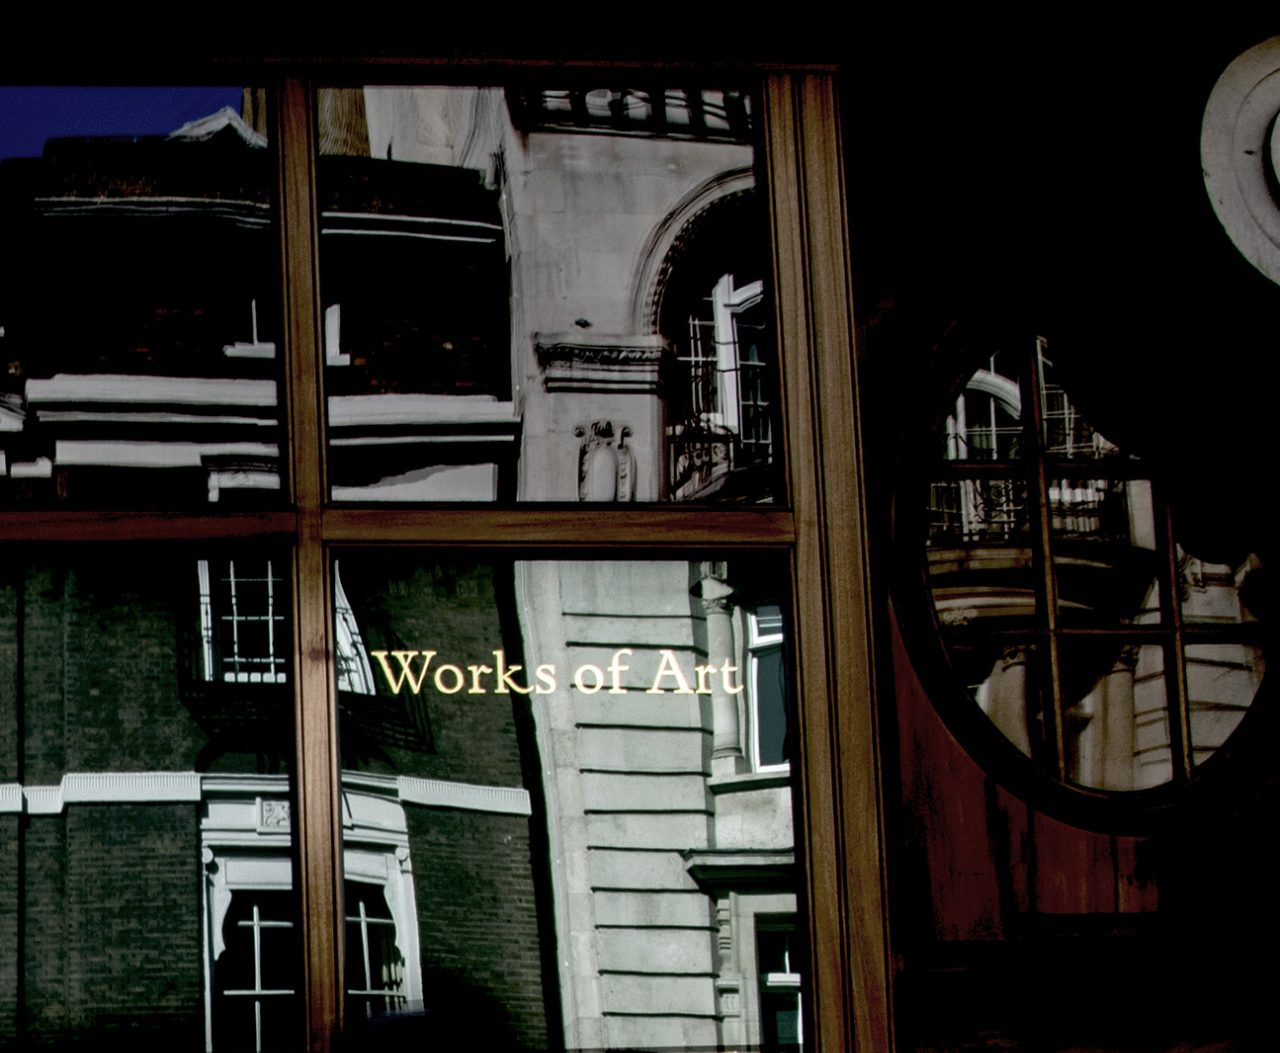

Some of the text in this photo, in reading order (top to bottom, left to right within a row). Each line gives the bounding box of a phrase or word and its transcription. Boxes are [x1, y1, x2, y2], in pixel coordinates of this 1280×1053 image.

[370, 648, 745, 695] Works of Art
